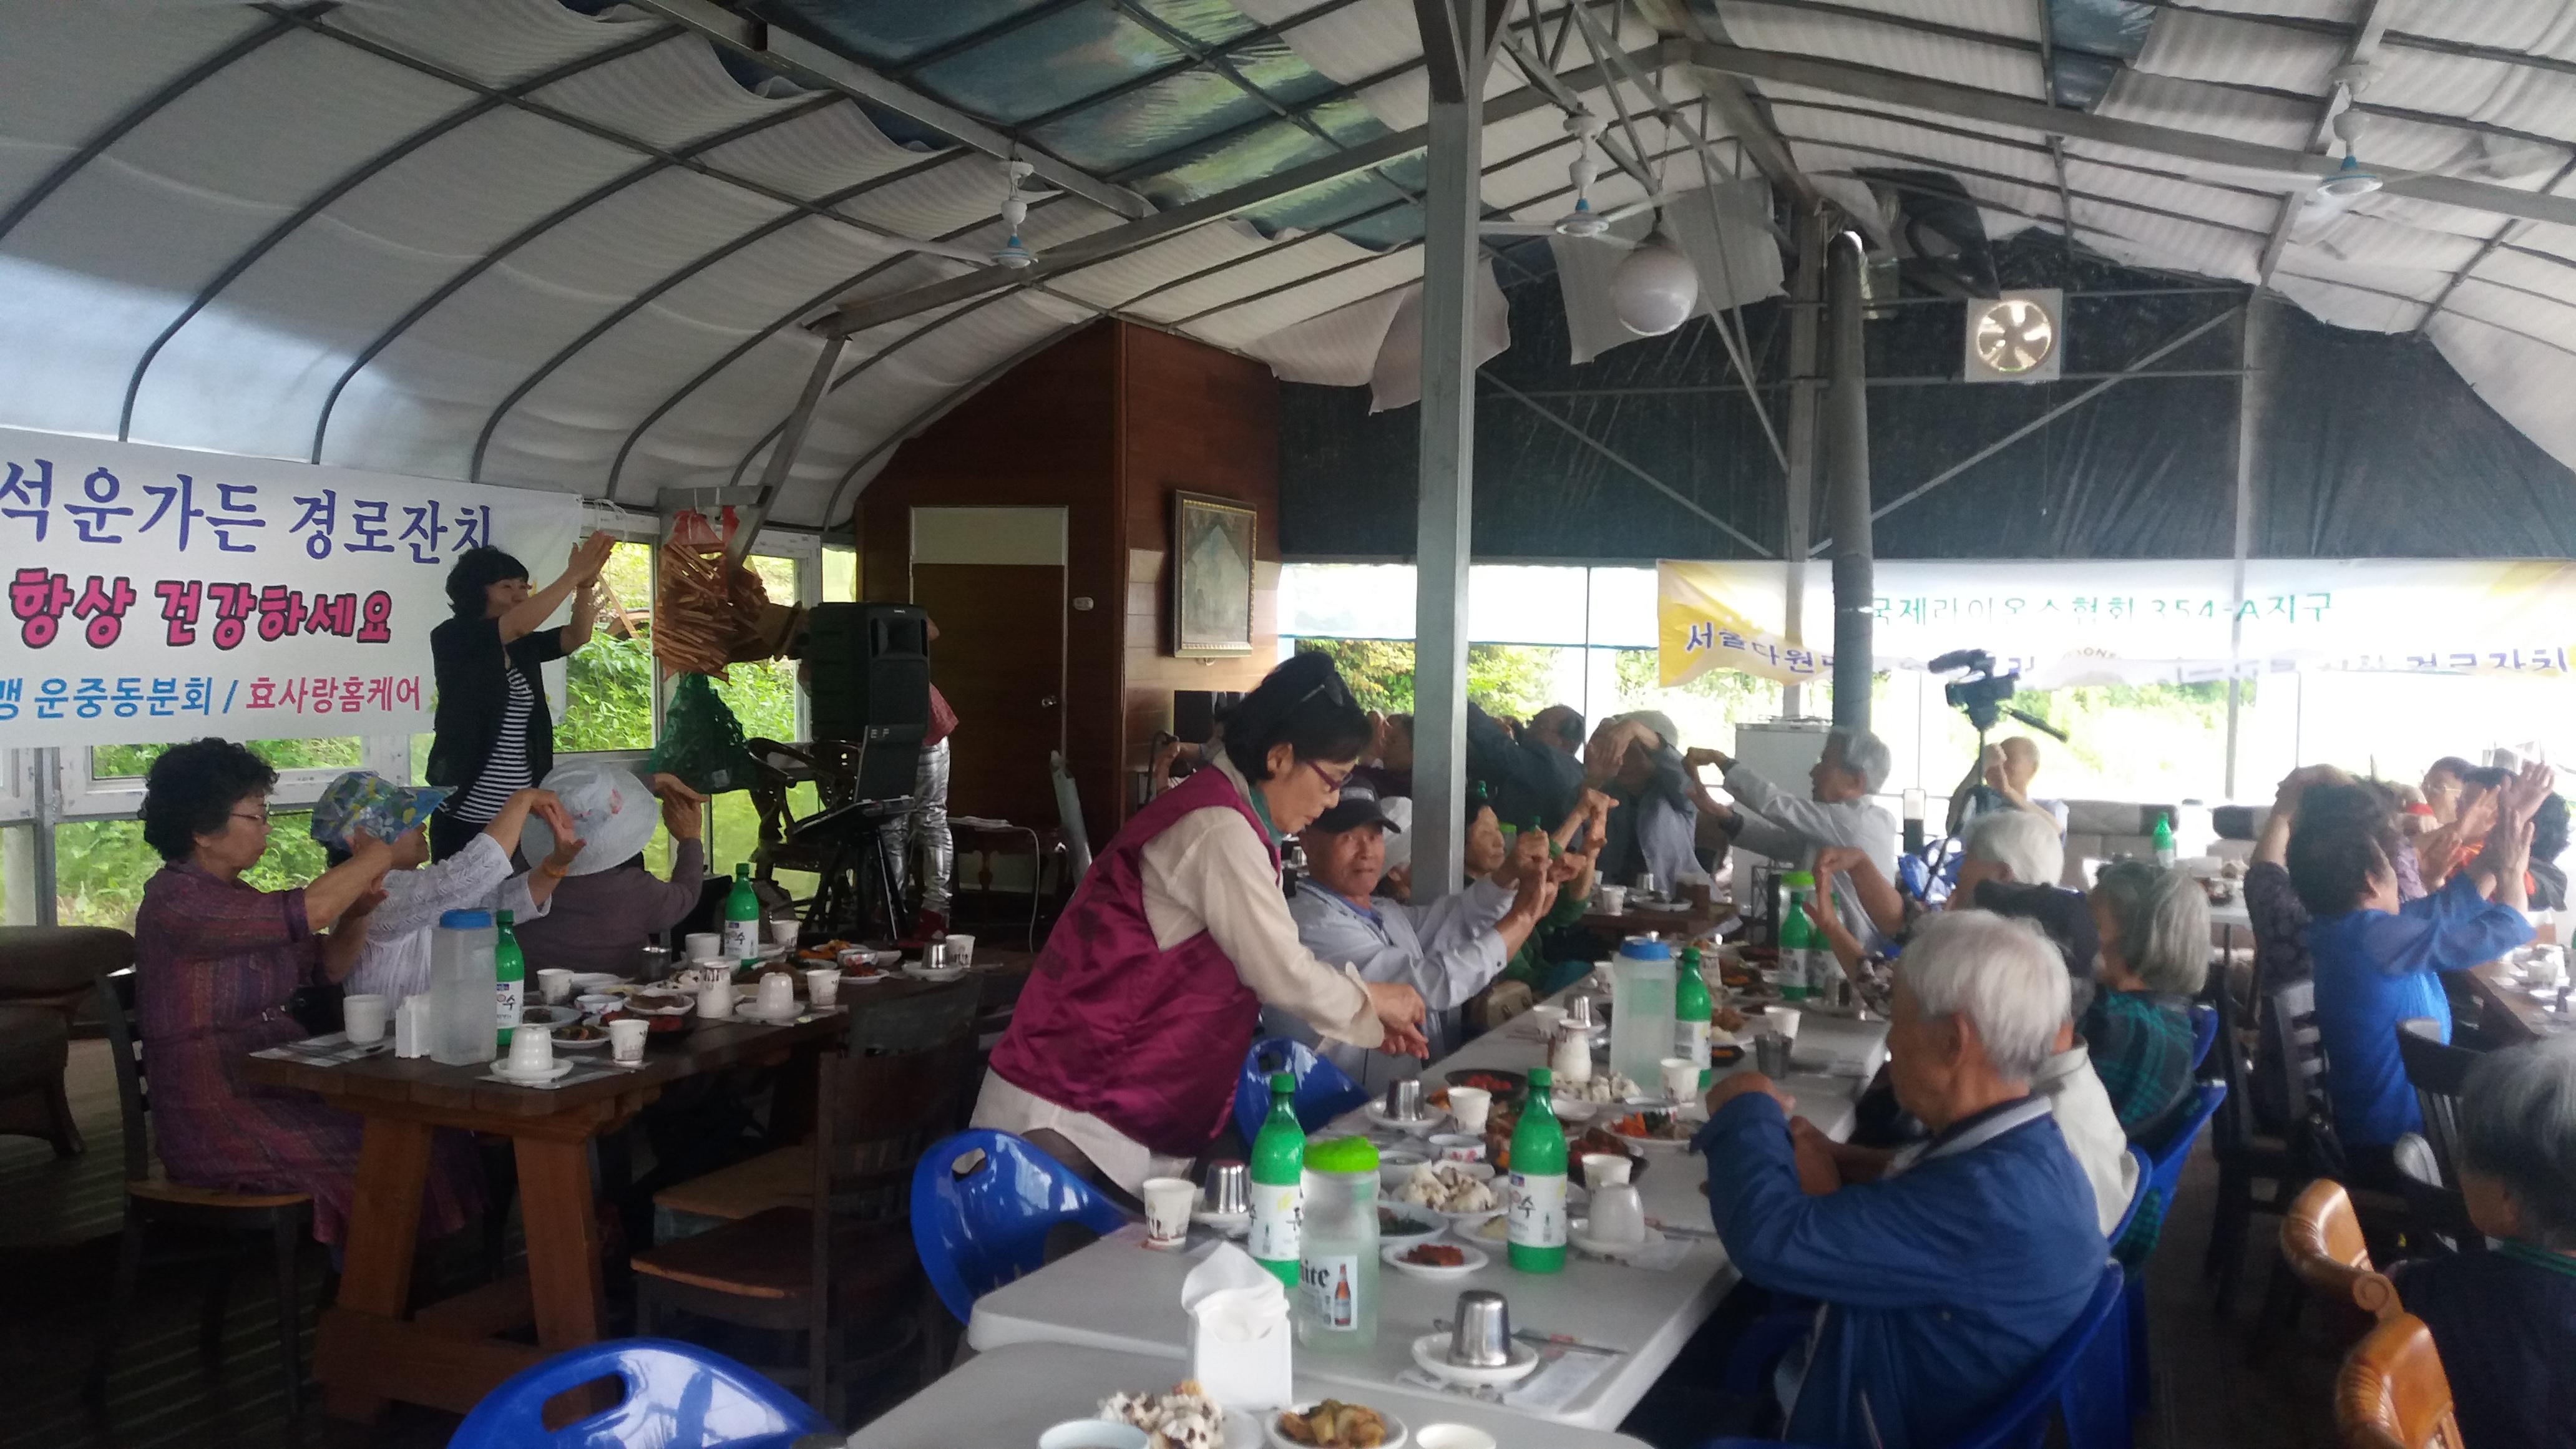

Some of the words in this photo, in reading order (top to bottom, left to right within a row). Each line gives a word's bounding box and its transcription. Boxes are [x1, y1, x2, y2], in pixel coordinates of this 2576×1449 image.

[0, 459, 266, 552] 석운가든
[289, 489, 490, 564] 경로잔치
[9, 567, 137, 649] 항상
[154, 580, 392, 651] 건강하세요
[34, 677, 213, 719] 운중동분회
[246, 676, 420, 714] 효사랑홈케어
